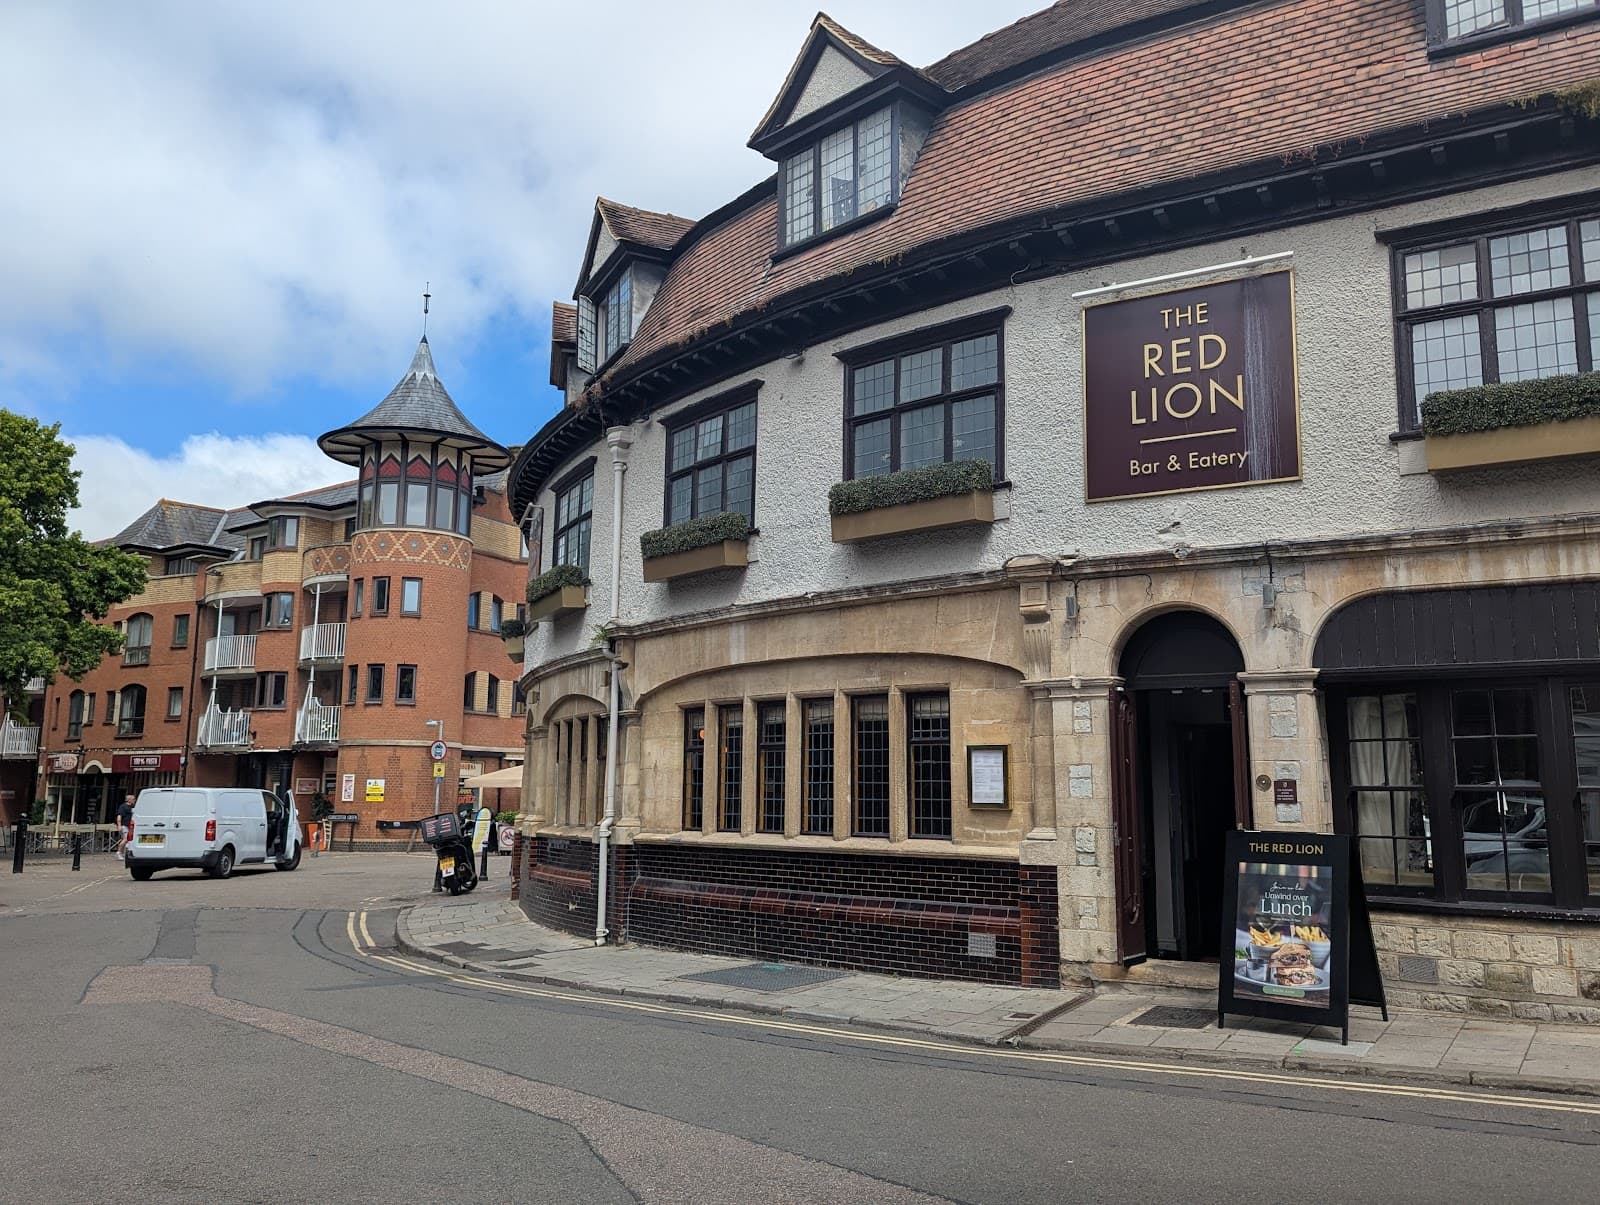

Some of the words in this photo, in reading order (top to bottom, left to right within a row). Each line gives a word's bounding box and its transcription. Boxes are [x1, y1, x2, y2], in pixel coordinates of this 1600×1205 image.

[1160, 303, 1209, 329] THE
[1143, 334, 1227, 379] RED
[1130, 375, 1245, 425] LION
[1129, 459, 1160, 477] Bar
[1167, 454, 1182, 472] &
[1189, 450, 1249, 470] Eatery
[1249, 842, 1270, 853] THE
[1272, 843, 1294, 854] RED
[1296, 844, 1323, 854] LION
[1261, 898, 1312, 917] Lunch
[1265, 892, 1291, 900] Unwind
